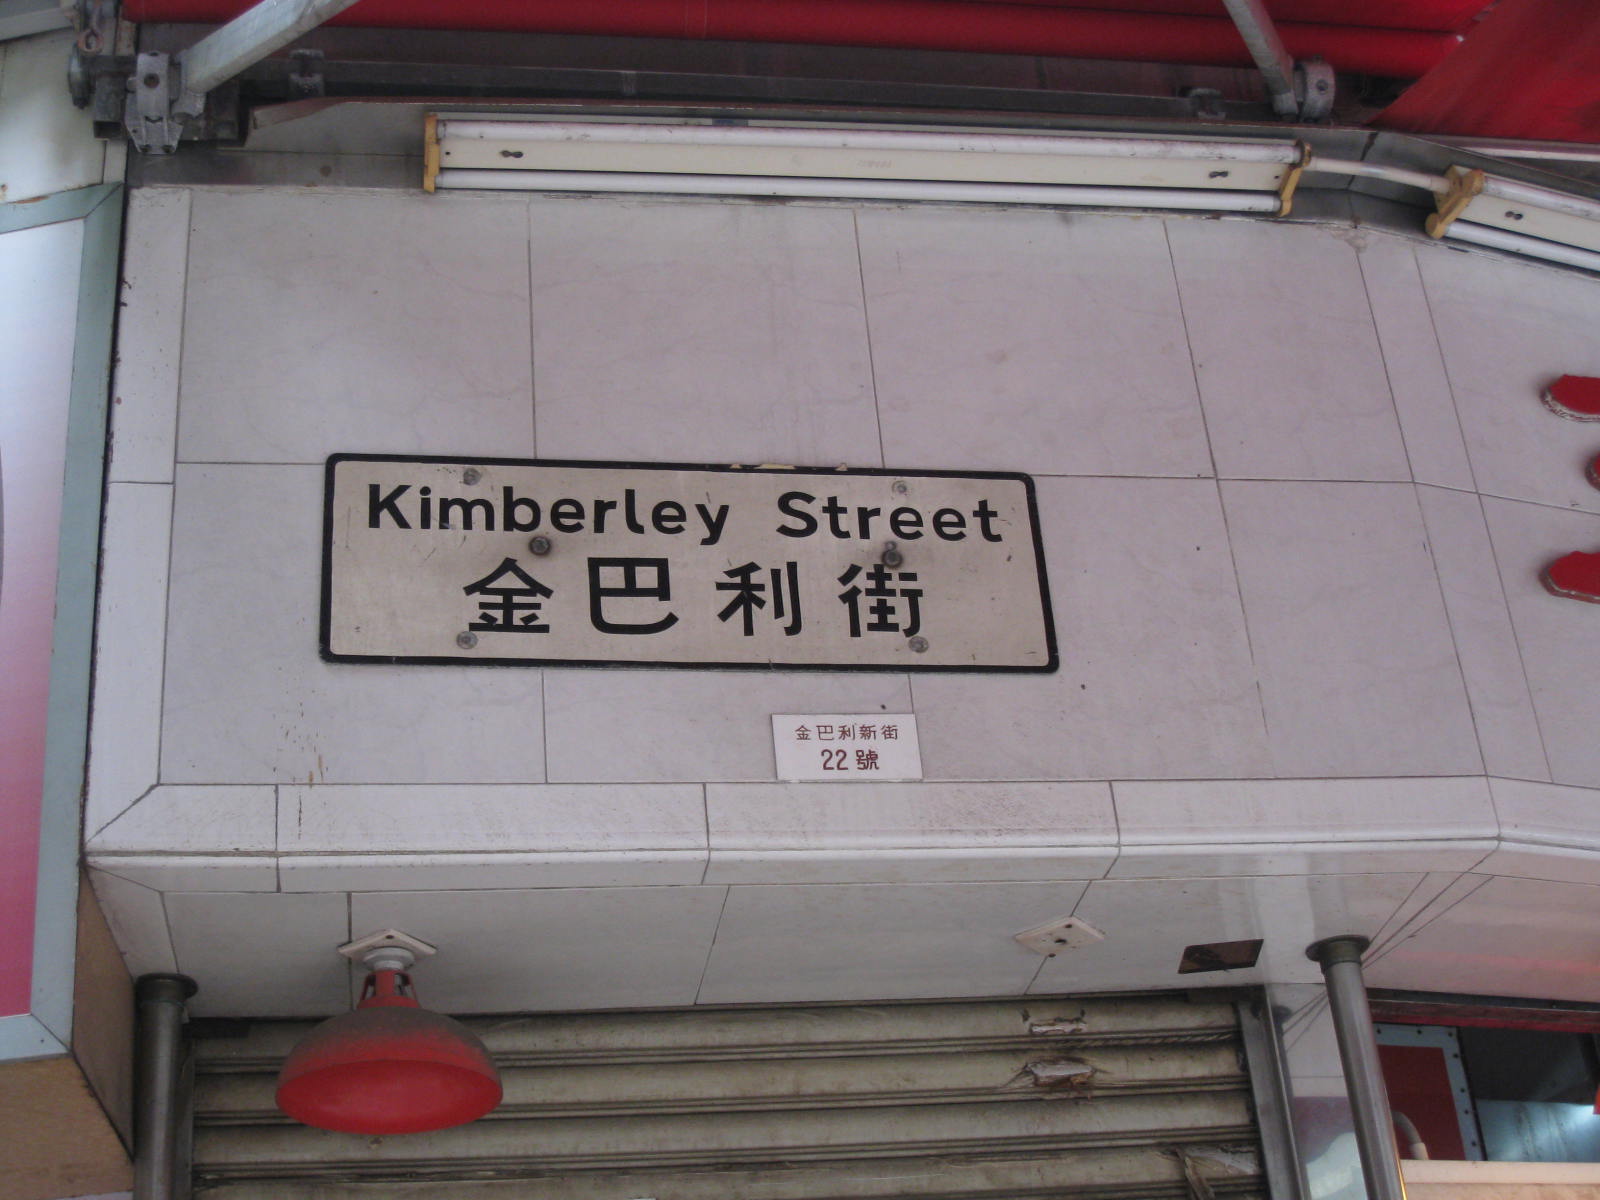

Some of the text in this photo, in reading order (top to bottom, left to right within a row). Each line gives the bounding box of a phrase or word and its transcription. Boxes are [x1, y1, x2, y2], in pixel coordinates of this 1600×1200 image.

[367, 483, 1003, 546] Kimberley Street
[463, 556, 924, 639] 金巴利街
[794, 724, 899, 742] 金巴利新街
